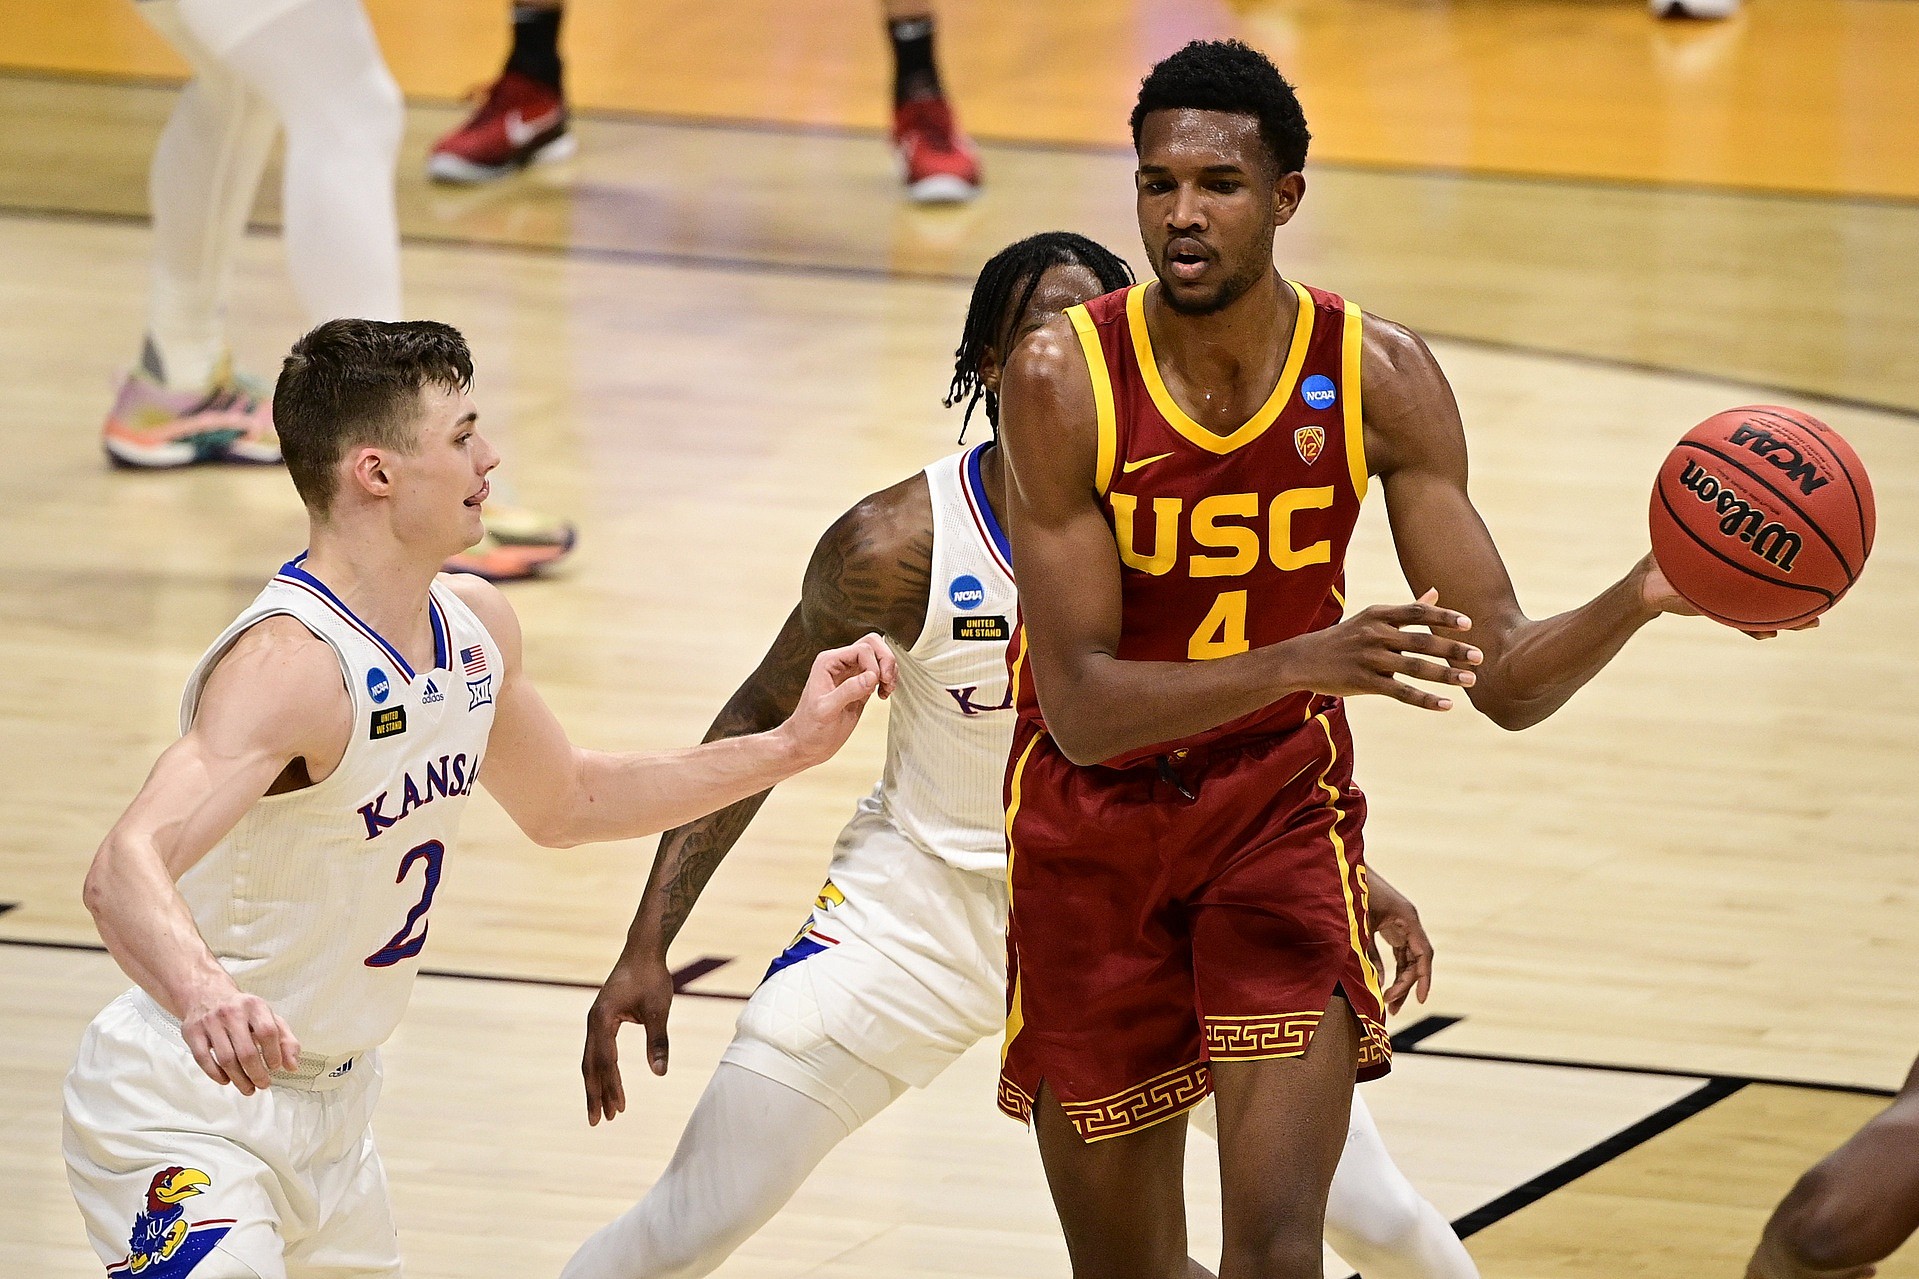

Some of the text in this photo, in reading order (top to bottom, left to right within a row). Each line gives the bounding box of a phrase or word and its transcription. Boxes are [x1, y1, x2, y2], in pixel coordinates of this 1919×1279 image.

[1306, 390, 1335, 401] NCAA
[1297, 427, 1323, 450] PAC
[1303, 442, 1317, 457] 12
[1729, 422, 1829, 496] NCAA
[1680, 459, 1803, 573] Wilson
[1109, 485, 1335, 578] USC
[953, 590, 983, 602] NCAA
[966, 619, 995, 628] UNITED
[1187, 589, 1250, 660] 4
[961, 628, 1002, 638] WE STAND
[371, 681, 389, 697] NCAA
[421, 692, 445, 705] adidas
[380, 710, 399, 723] UNITED
[376, 720, 403, 735] WE STAND
[364, 838, 445, 968] 2
[145, 1217, 165, 1241] KU
